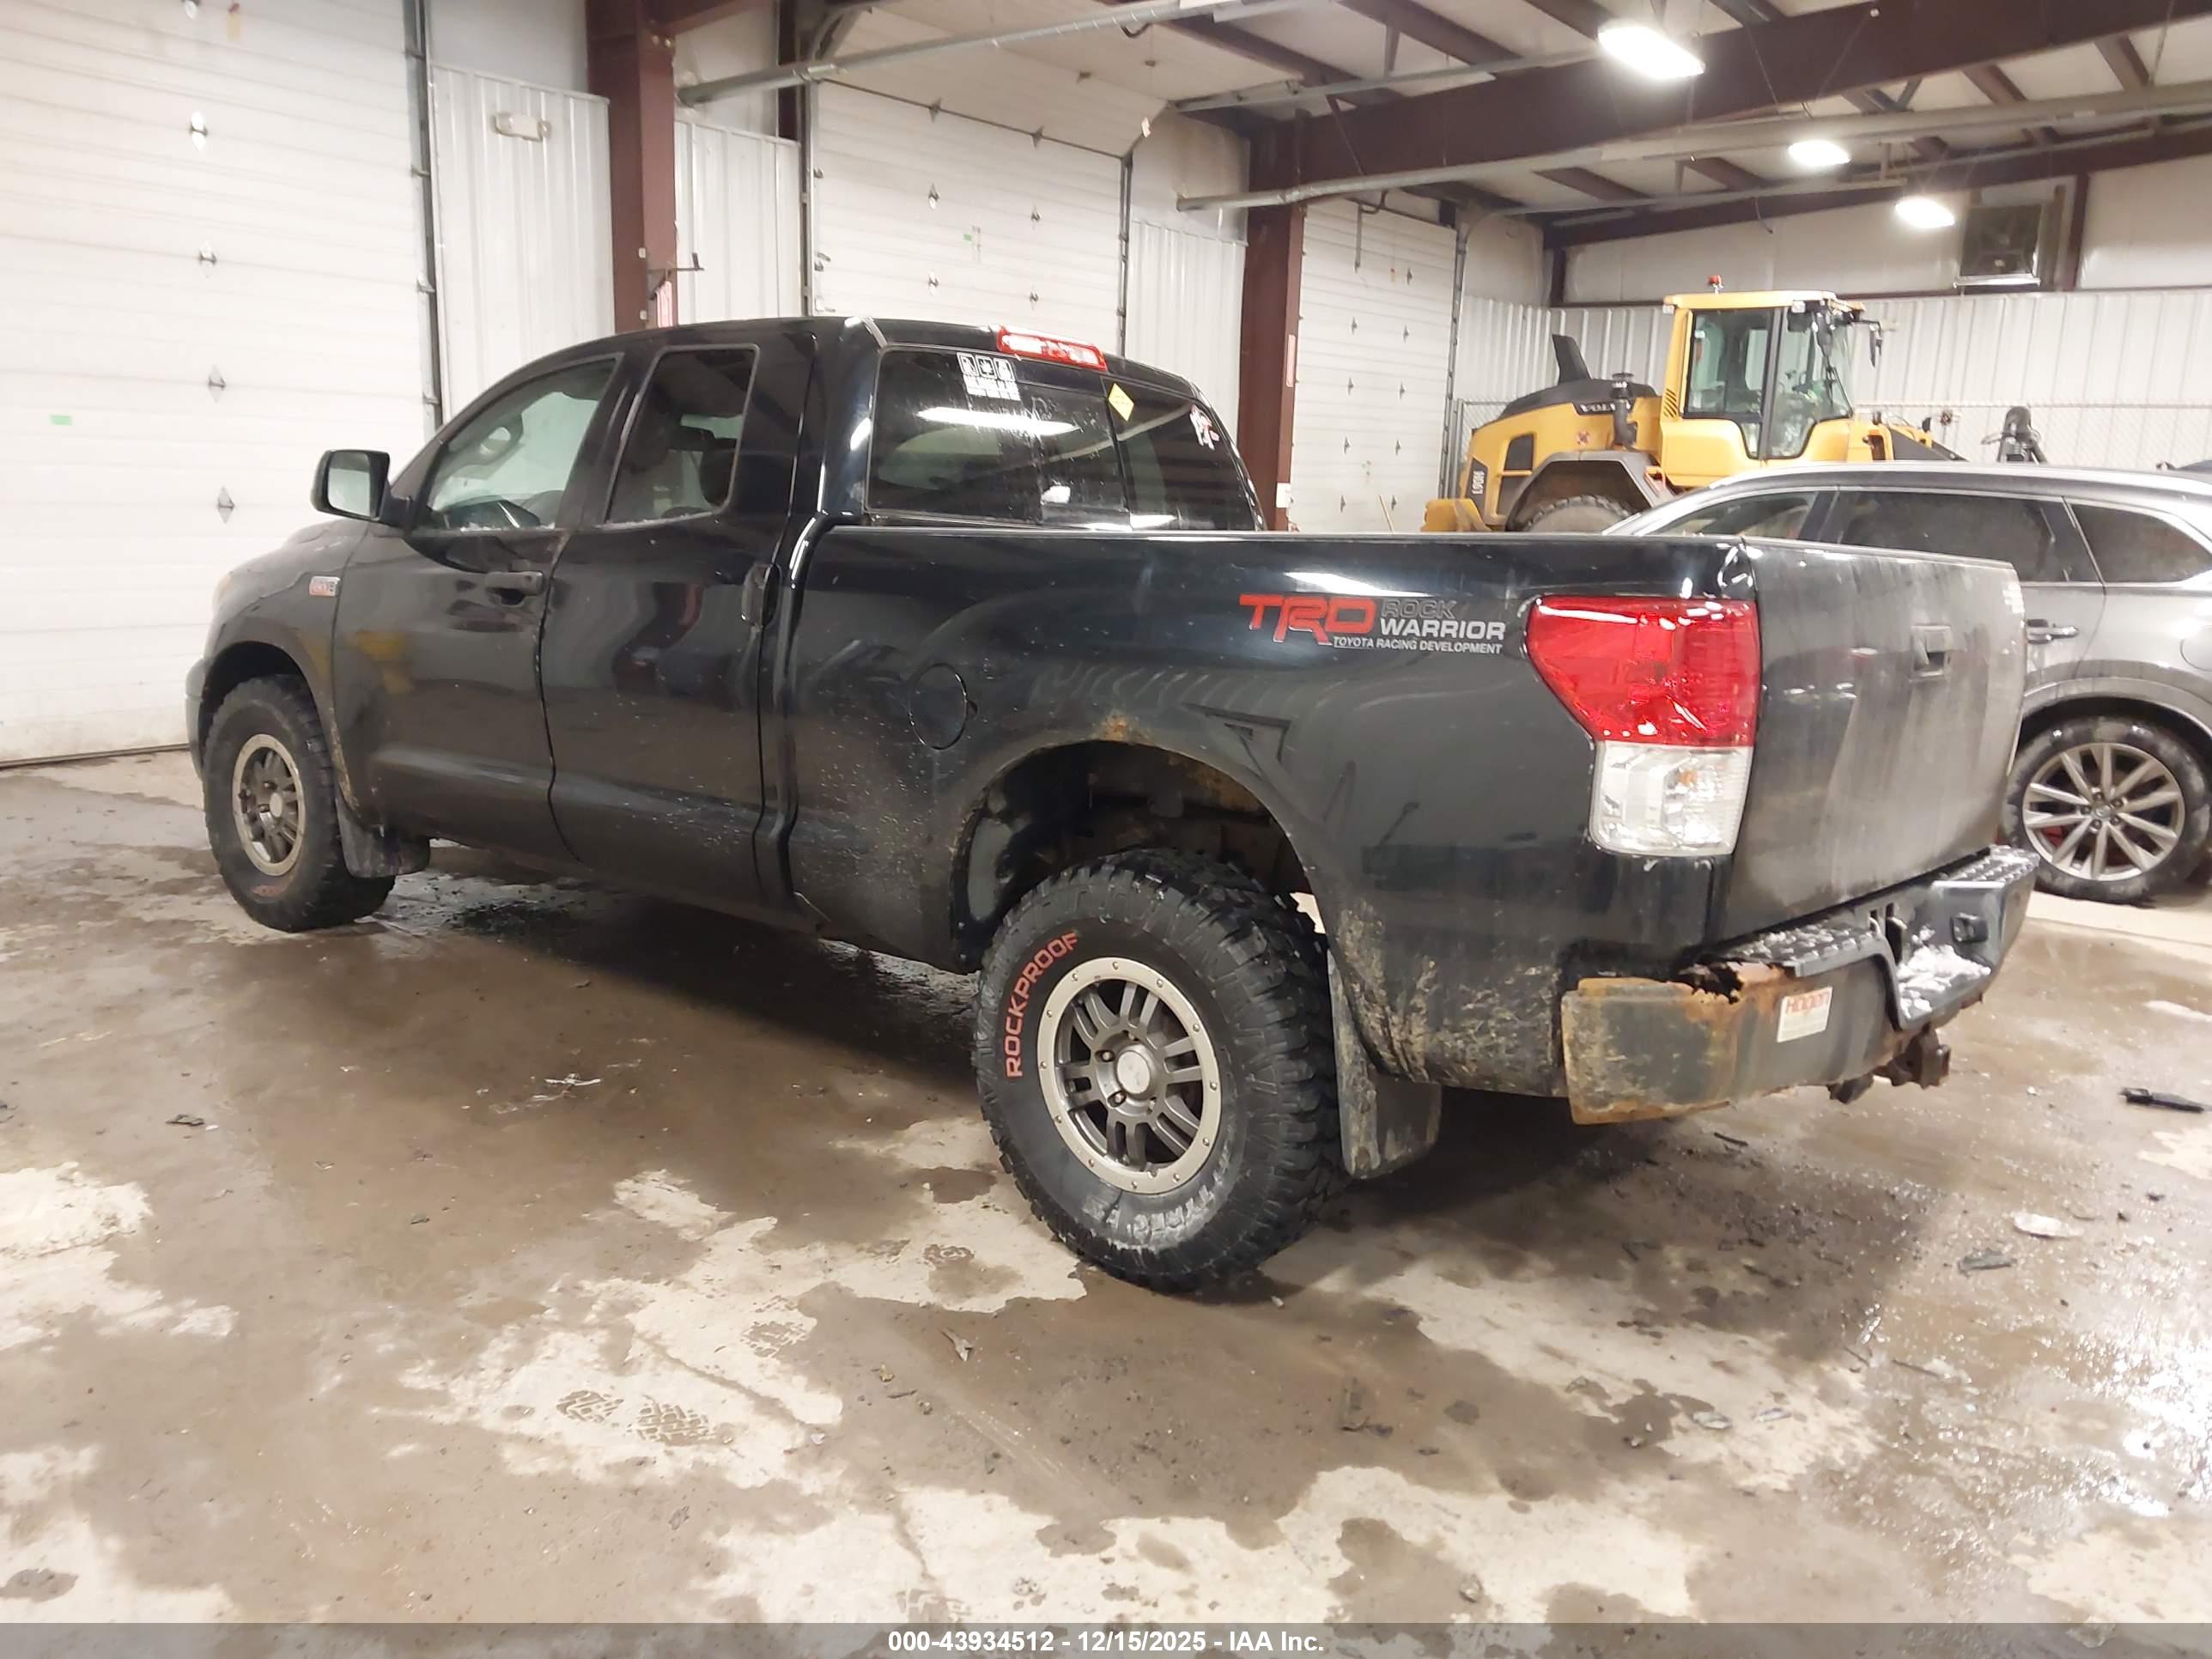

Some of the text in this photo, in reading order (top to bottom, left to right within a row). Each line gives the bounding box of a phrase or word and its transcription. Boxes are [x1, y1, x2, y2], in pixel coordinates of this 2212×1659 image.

[1239, 593, 1377, 646] TRD
[1381, 599, 1457, 619] ROCK
[1380, 617, 1506, 641] WARRIOR
[1333, 635, 1504, 655] TOYOTA RACING DEVELOPMENT
[1005, 931, 1079, 1079] ROCKPROOF
